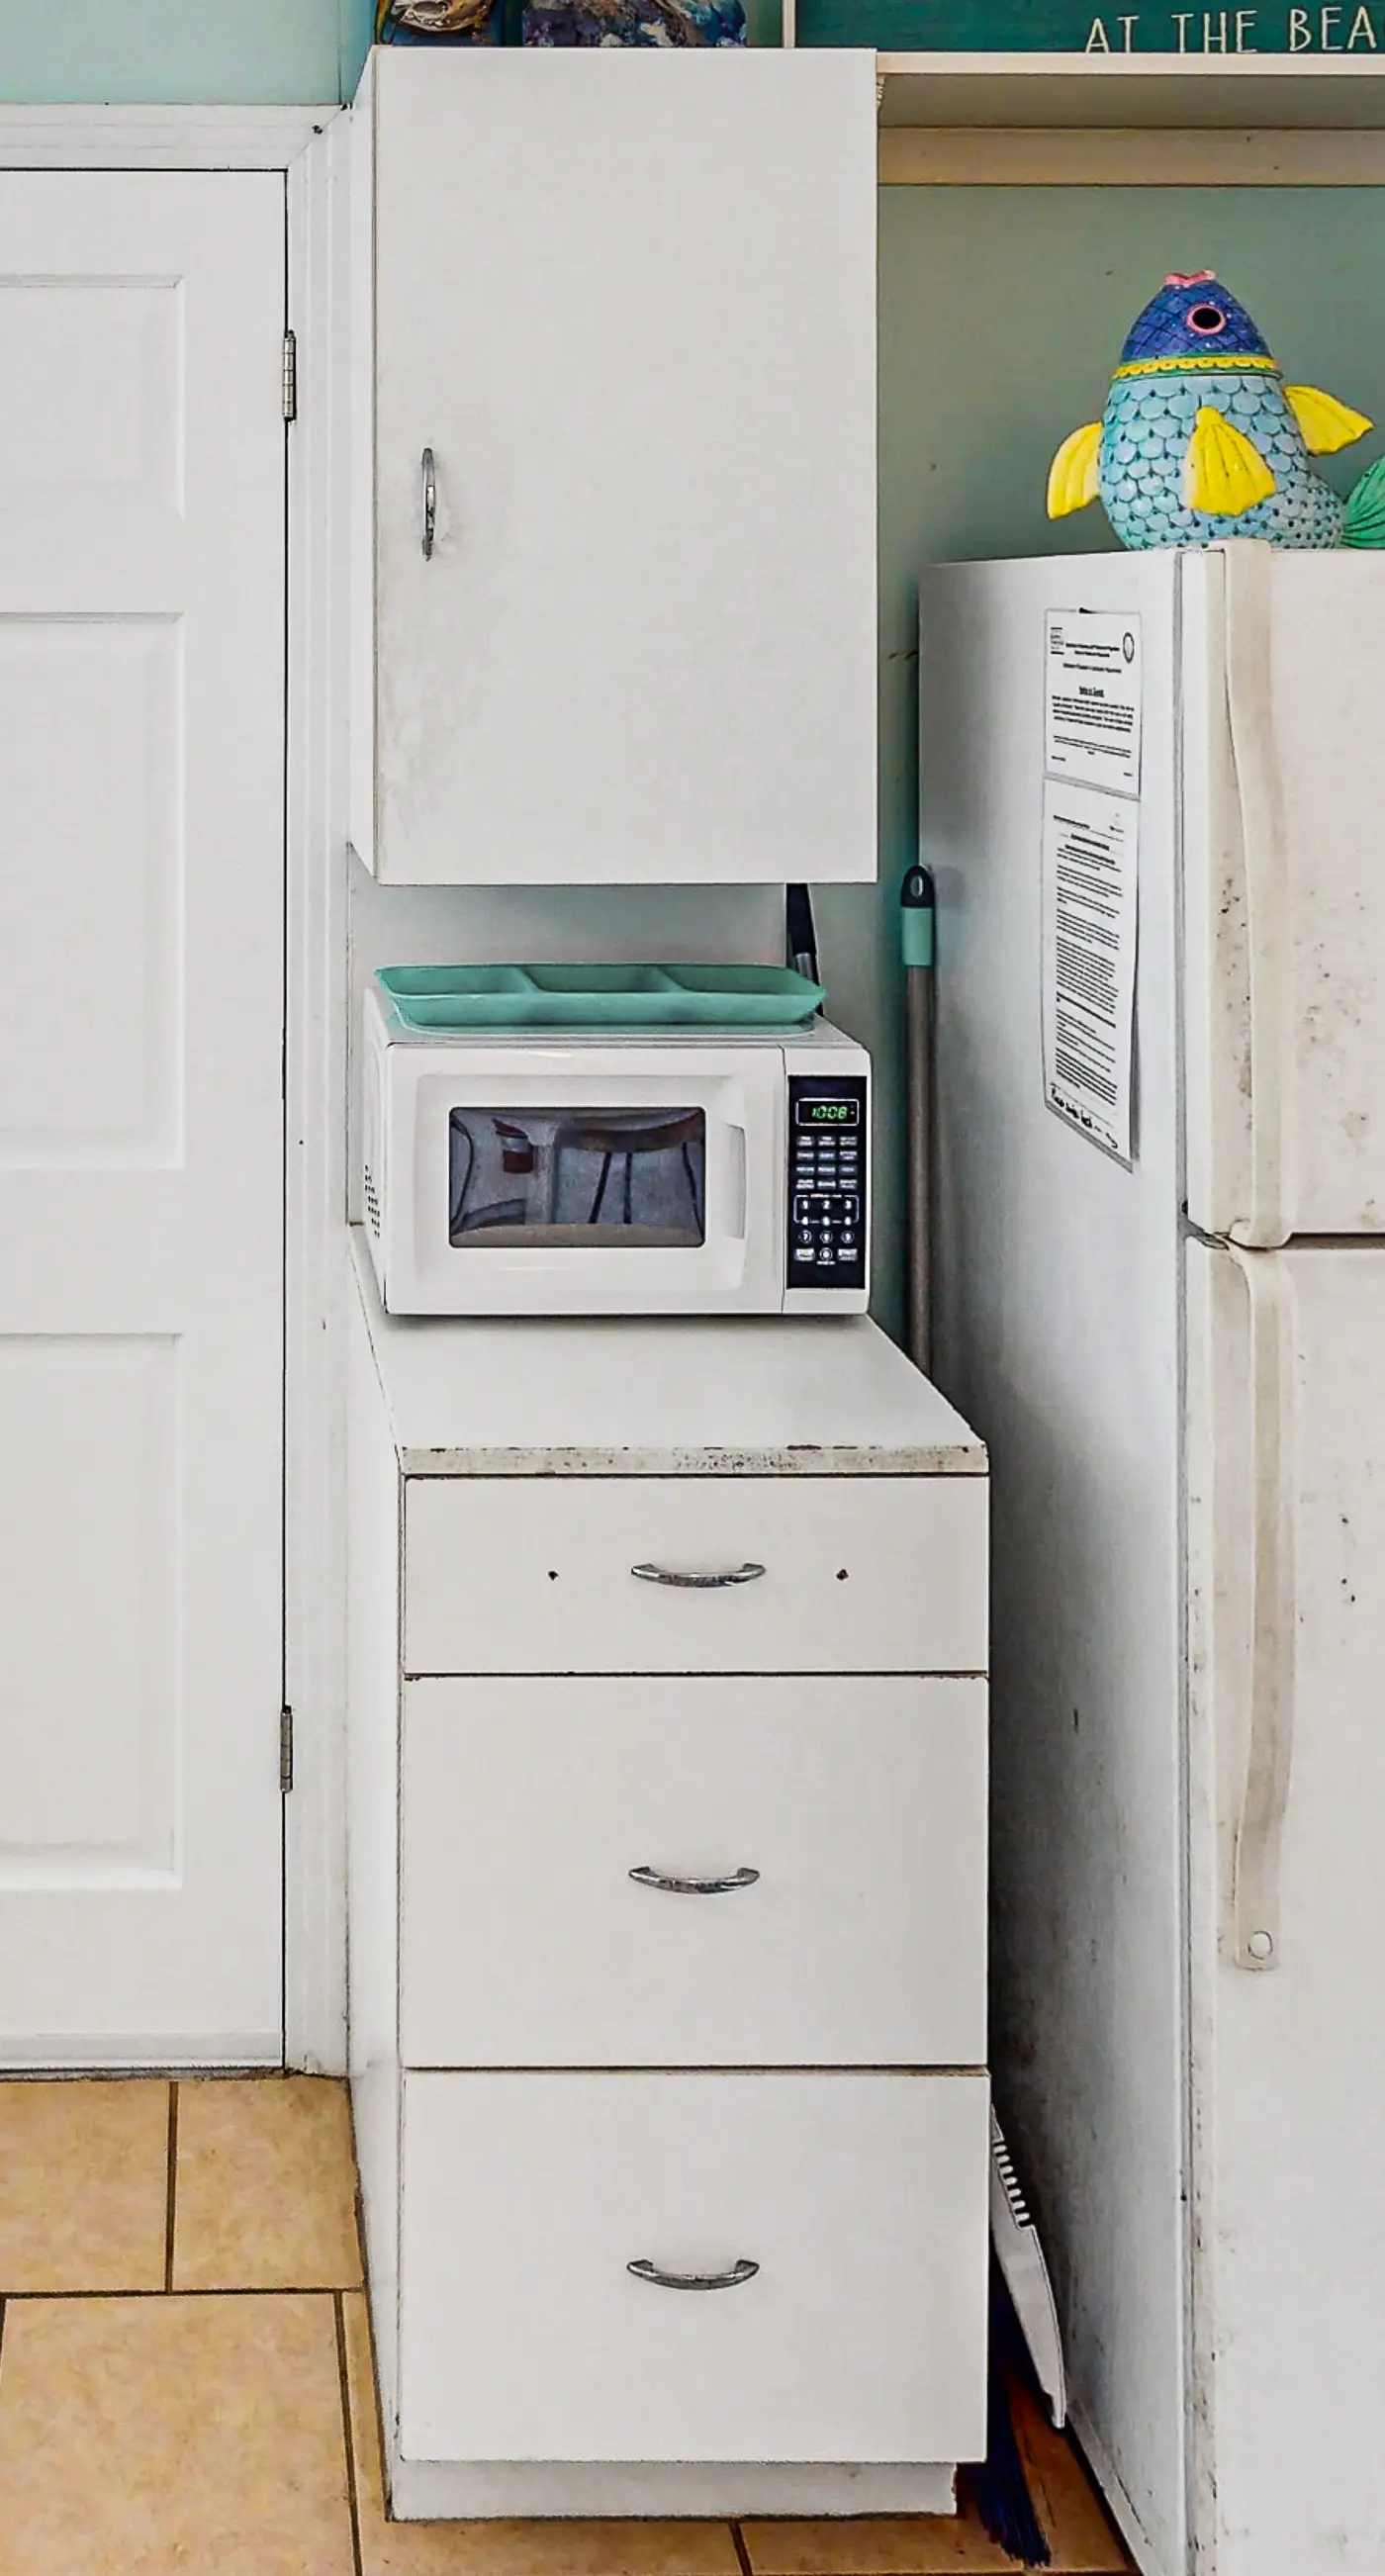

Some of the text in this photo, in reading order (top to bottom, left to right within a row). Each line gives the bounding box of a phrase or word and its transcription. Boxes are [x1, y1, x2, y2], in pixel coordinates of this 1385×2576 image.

[1085, 16, 1140, 53] AT
[1170, 10, 1257, 53] THE
[822, 1200, 831, 1210] 2
